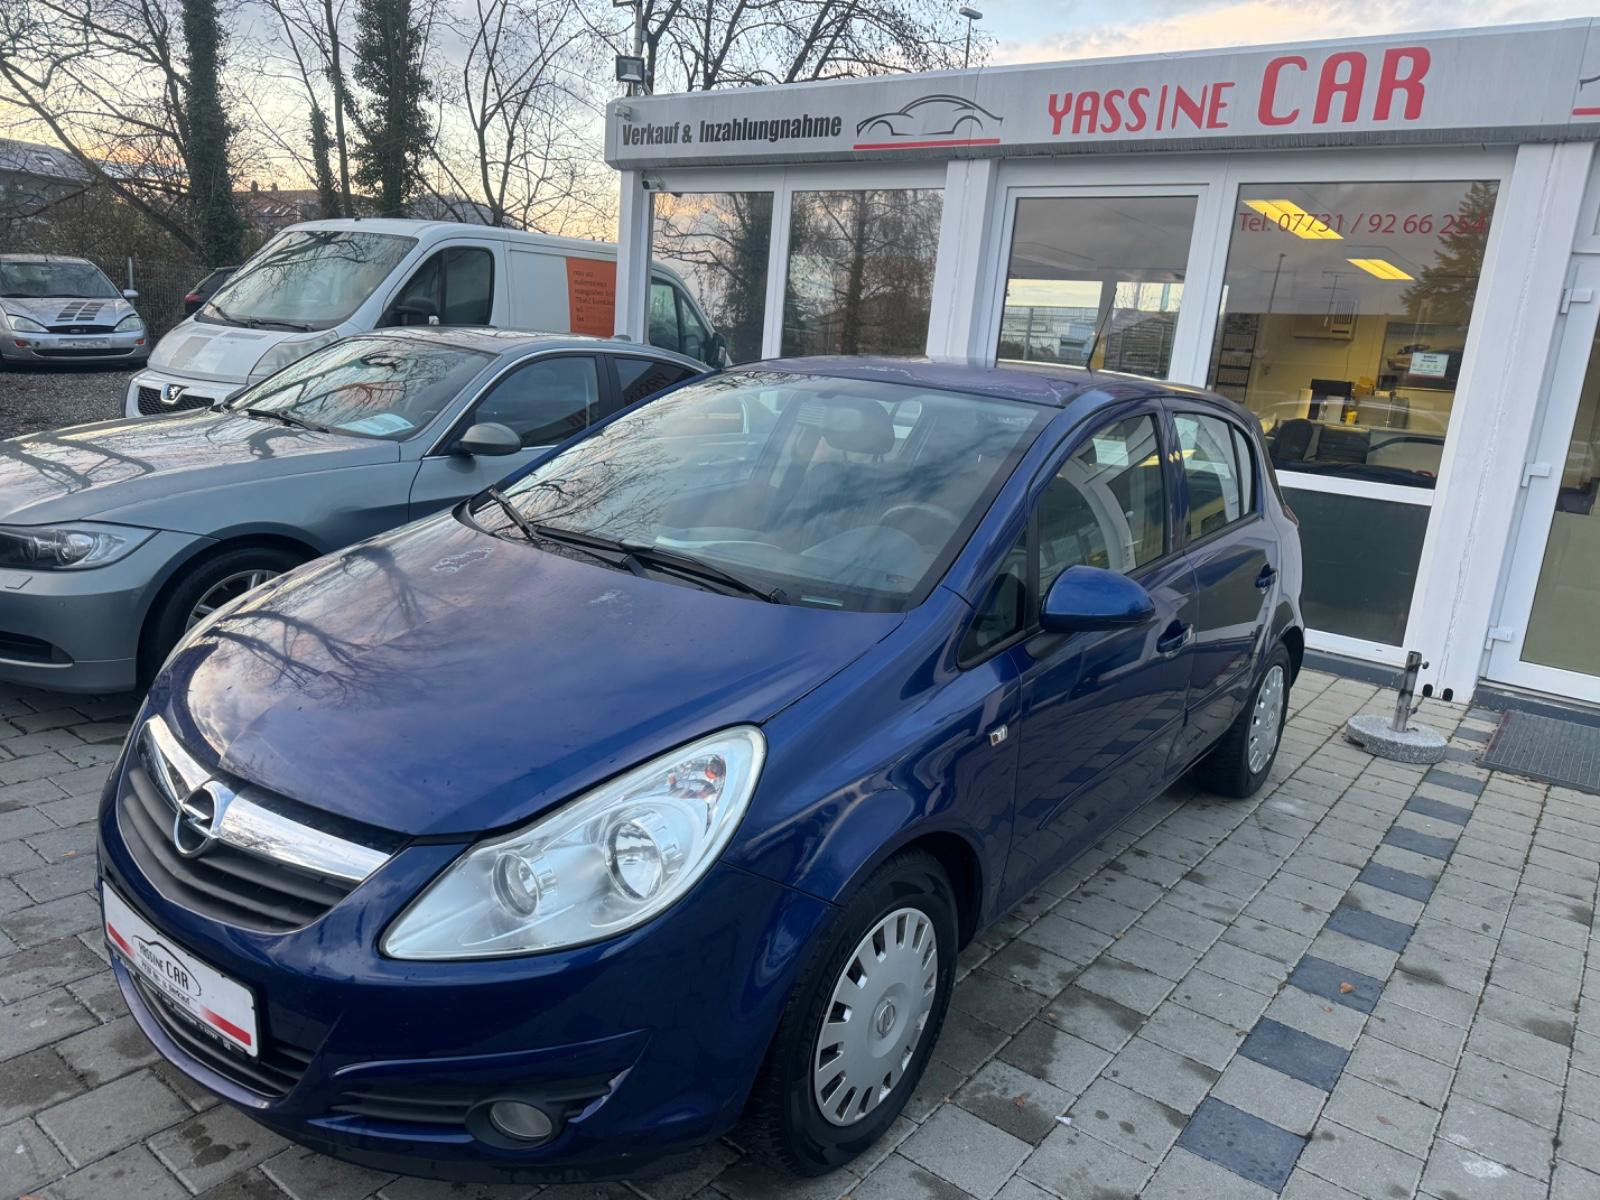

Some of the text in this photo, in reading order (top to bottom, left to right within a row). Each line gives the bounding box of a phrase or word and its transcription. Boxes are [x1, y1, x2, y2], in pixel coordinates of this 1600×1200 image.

[1048, 46, 1433, 136] YASSINE CAR
[622, 114, 843, 146] Verkauf & Inzahlungnahme
[1239, 212, 1272, 233] Tel.
[1278, 213, 1343, 233] 07731
[1368, 213, 1397, 234] 92
[1403, 213, 1433, 234] 66
[166, 960, 189, 991] CAR
